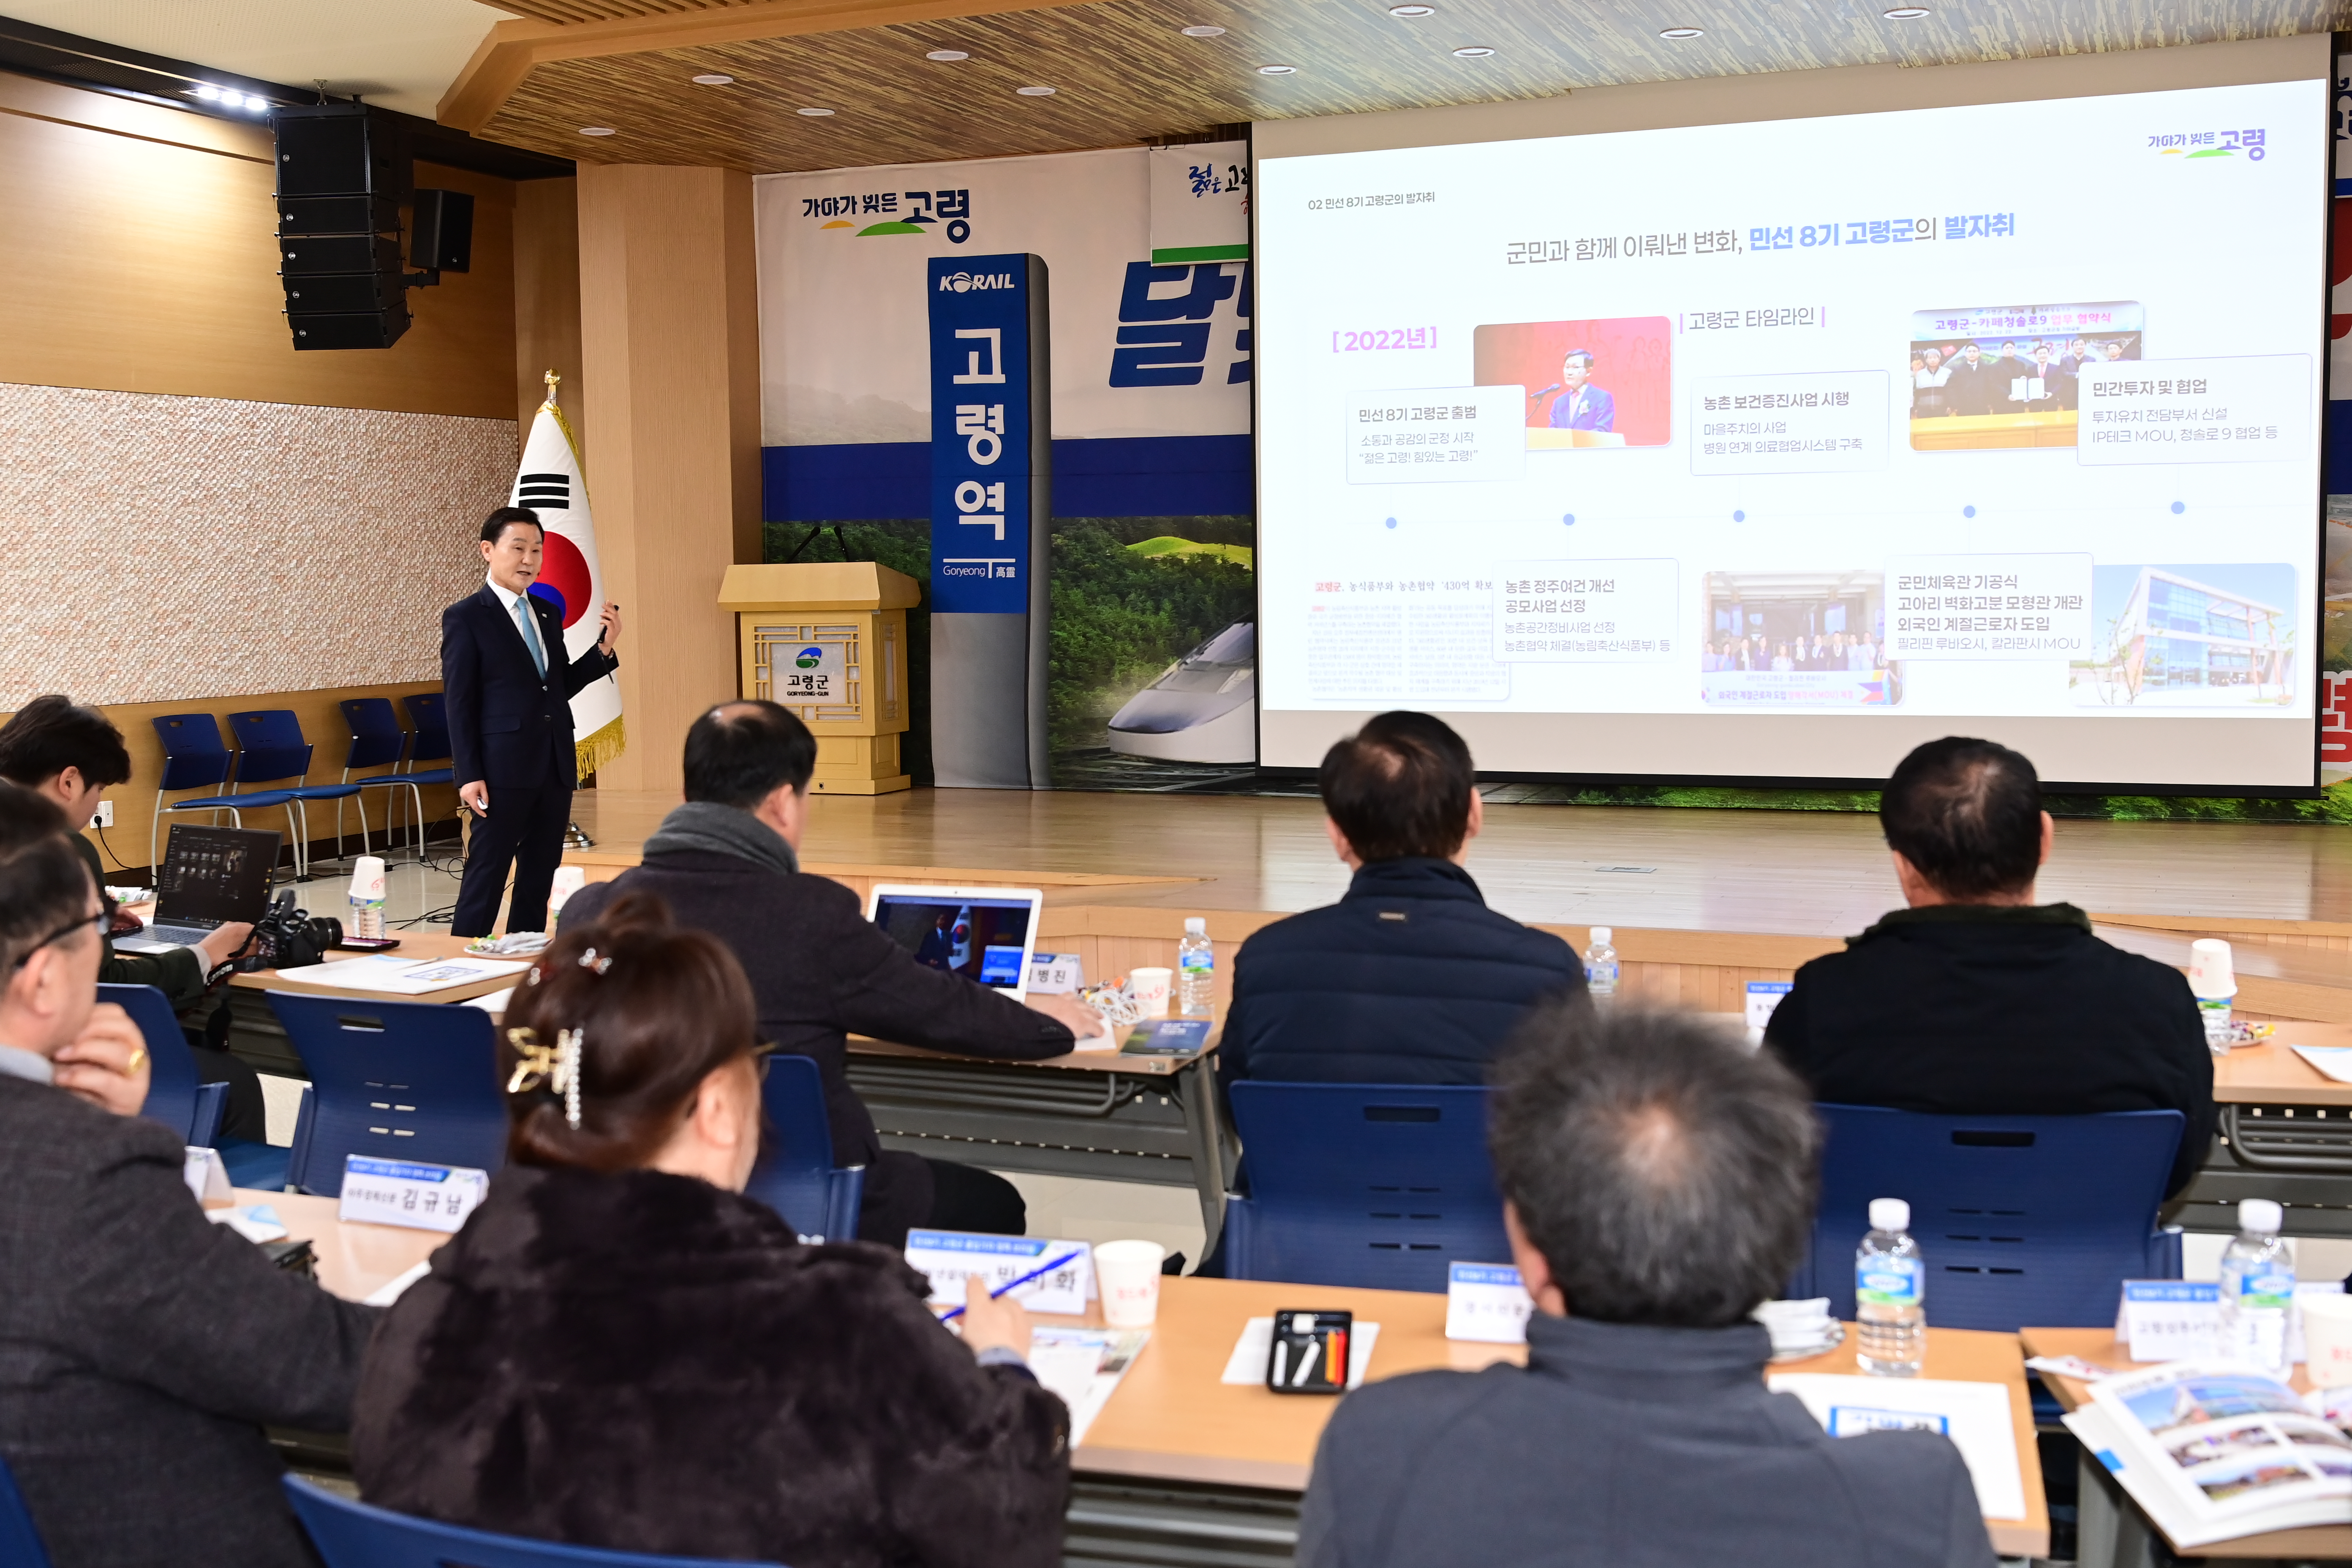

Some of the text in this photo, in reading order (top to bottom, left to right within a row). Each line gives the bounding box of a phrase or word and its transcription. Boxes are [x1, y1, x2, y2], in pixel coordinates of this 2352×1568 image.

[2148, 134, 2186, 147] 가야가
[2217, 129, 2266, 161] 고령
[1308, 192, 1435, 210] 02 민선 8기 고령군의 발자취
[803, 196, 857, 217] 가야가
[901, 189, 971, 244] 고령
[1507, 213, 2014, 264] 군민과 함께 이뤄낸 변화, 민선 8기 고령군의 발자취
[939, 272, 1014, 293] KORAIL
[1689, 307, 1813, 329] 고령군 타임라인
[2093, 379, 2206, 397] 민간투자 및 협업
[1704, 392, 1848, 410] 농촌 보건증진사업 시행
[1359, 406, 1476, 422] 민선 8기 고령군 출범
[2093, 408, 2227, 423] 투자유치 전담부서 신설
[953, 328, 1005, 540] 고령역
[1704, 422, 1786, 435] 마을주치의 사업
[2093, 426, 2277, 443] IP테크 MOU, 청솔로 9 협업 등
[1361, 432, 1474, 446] 소통과 공감의 군정 시작
[1704, 438, 1862, 455] 병원 연계 의료협업시스템 구축
[1387, 452, 1410, 463] 고령!
[1414, 451, 1445, 463] 힘있는
[943, 566, 985, 577] Goryeong
[1350, 581, 1393, 592] 농식품부와
[1399, 581, 1435, 591] 농촌협약
[1506, 579, 1614, 593] 농촌 정주여건 개선
[1899, 575, 2017, 590] 군민체육관 기공식
[1506, 599, 1585, 613] 공모사업 선정
[1898, 596, 2083, 610] 고아리 벽화고분 모형관 개관
[1505, 622, 1614, 634] 농촌공간정비사업 선정
[1898, 617, 2049, 631] 외국인 계절근로자 도입
[1505, 640, 1547, 651] 농촌협약
[1660, 640, 1670, 651] 등
[1898, 638, 1933, 649] 필리핀
[1936, 638, 1987, 651] 루바오시,
[2044, 637, 2080, 649] MOU
[788, 675, 828, 690] 고령군
